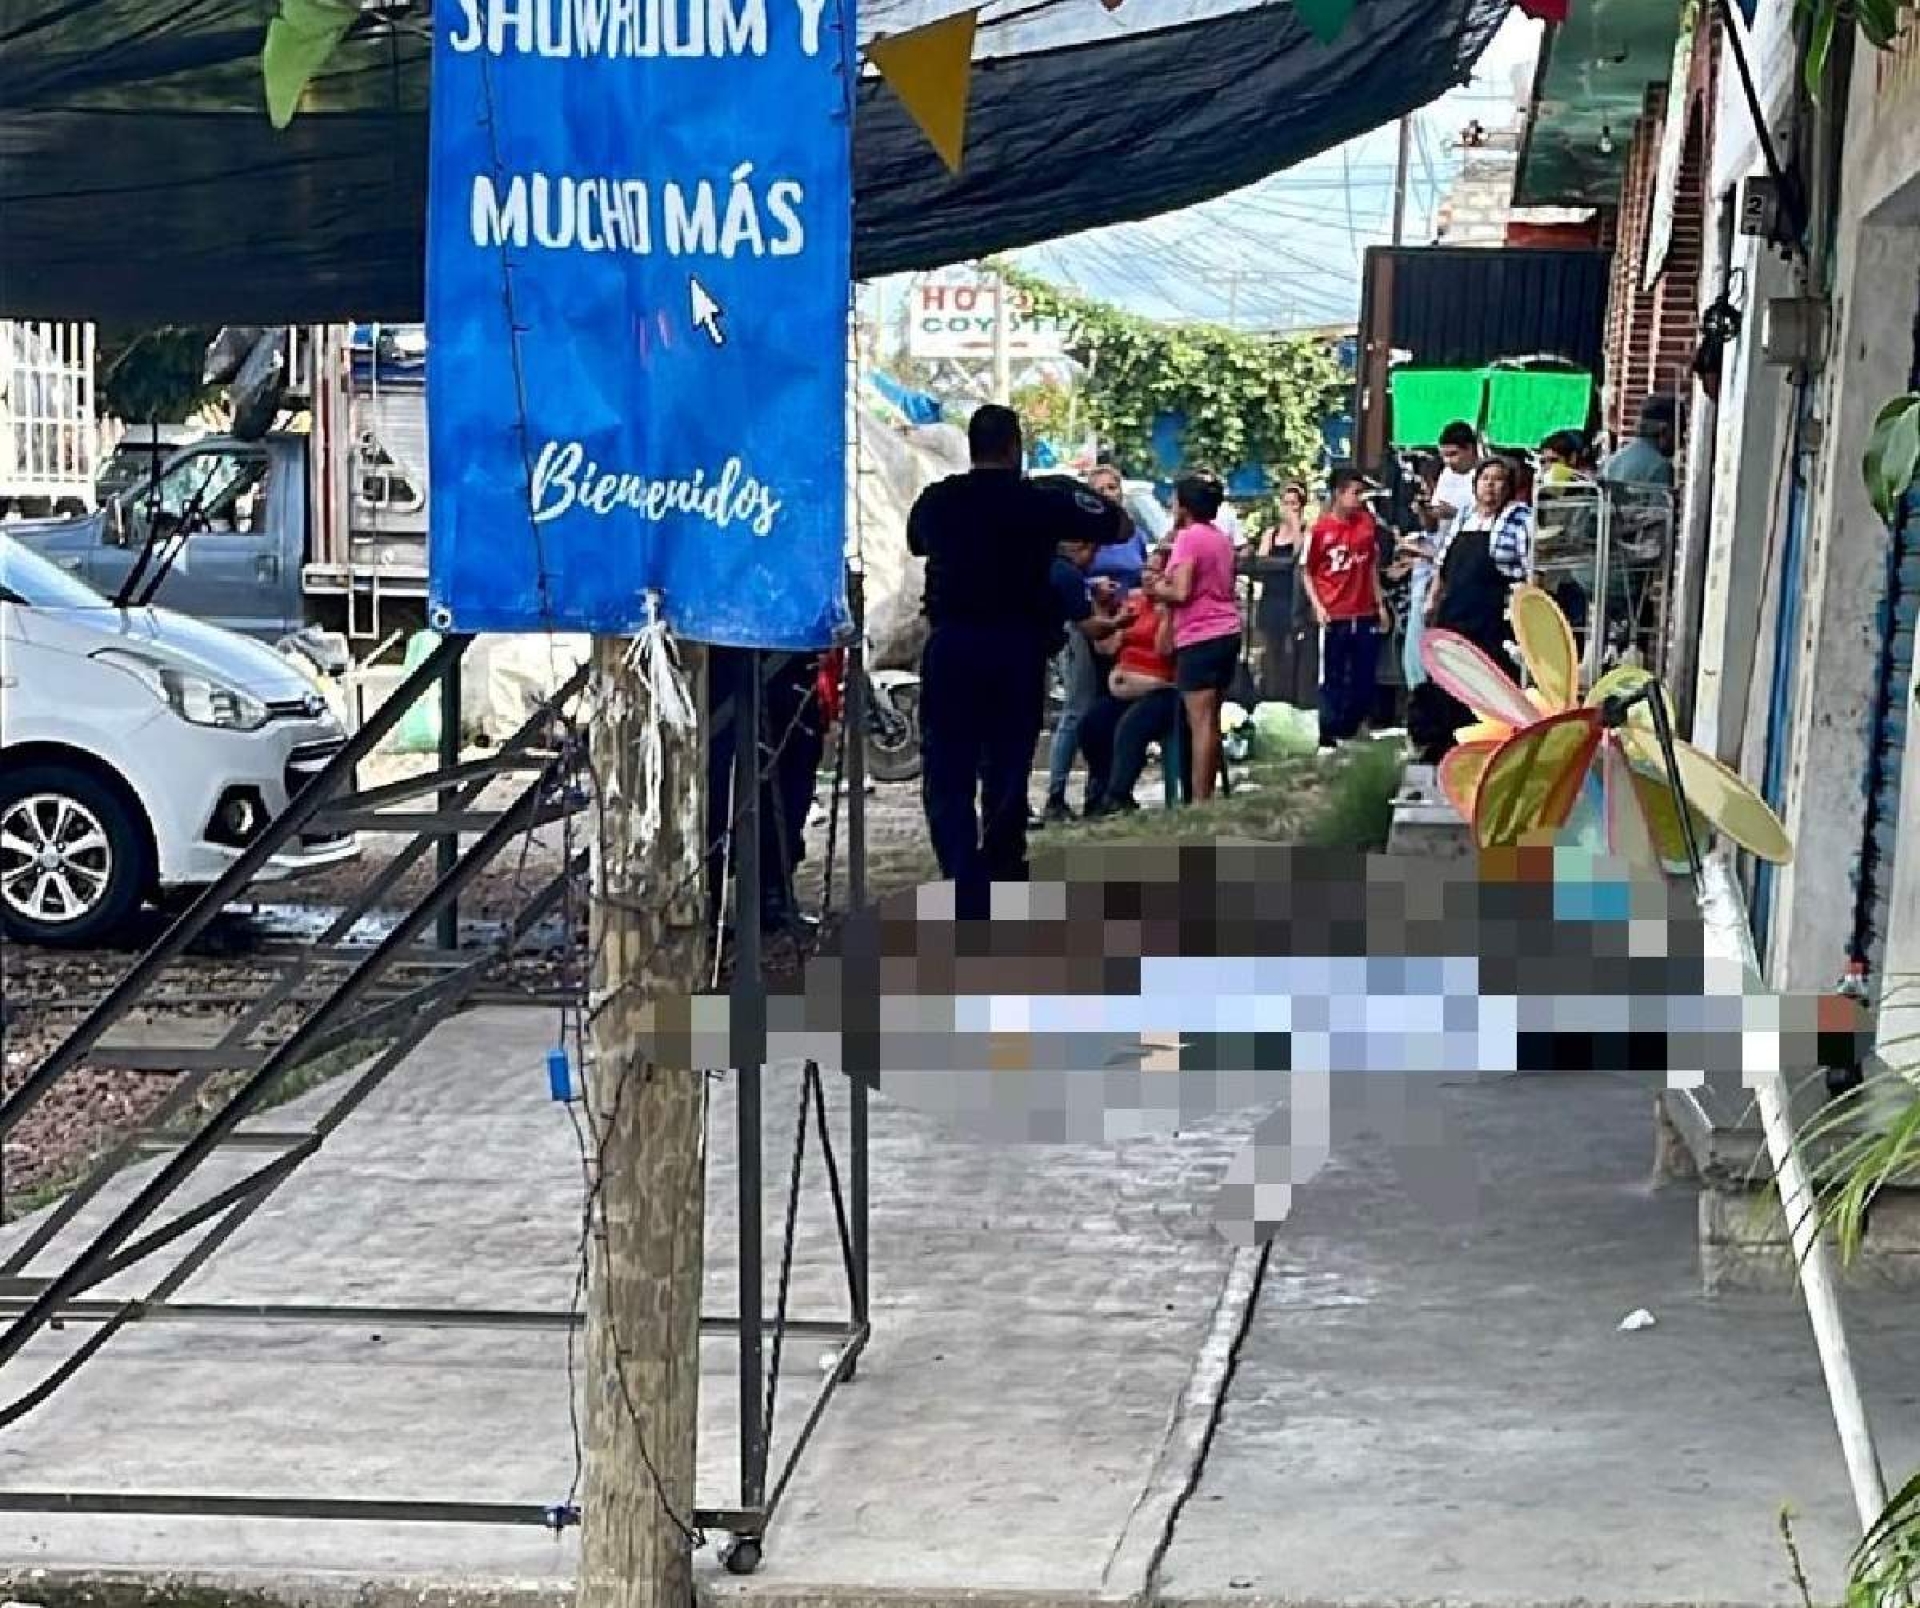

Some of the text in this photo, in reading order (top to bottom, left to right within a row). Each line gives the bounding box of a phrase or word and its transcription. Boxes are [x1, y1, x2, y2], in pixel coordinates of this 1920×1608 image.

[471, 161, 804, 259] MUCHO MÁS
[529, 441, 781, 536] Bienenidos
